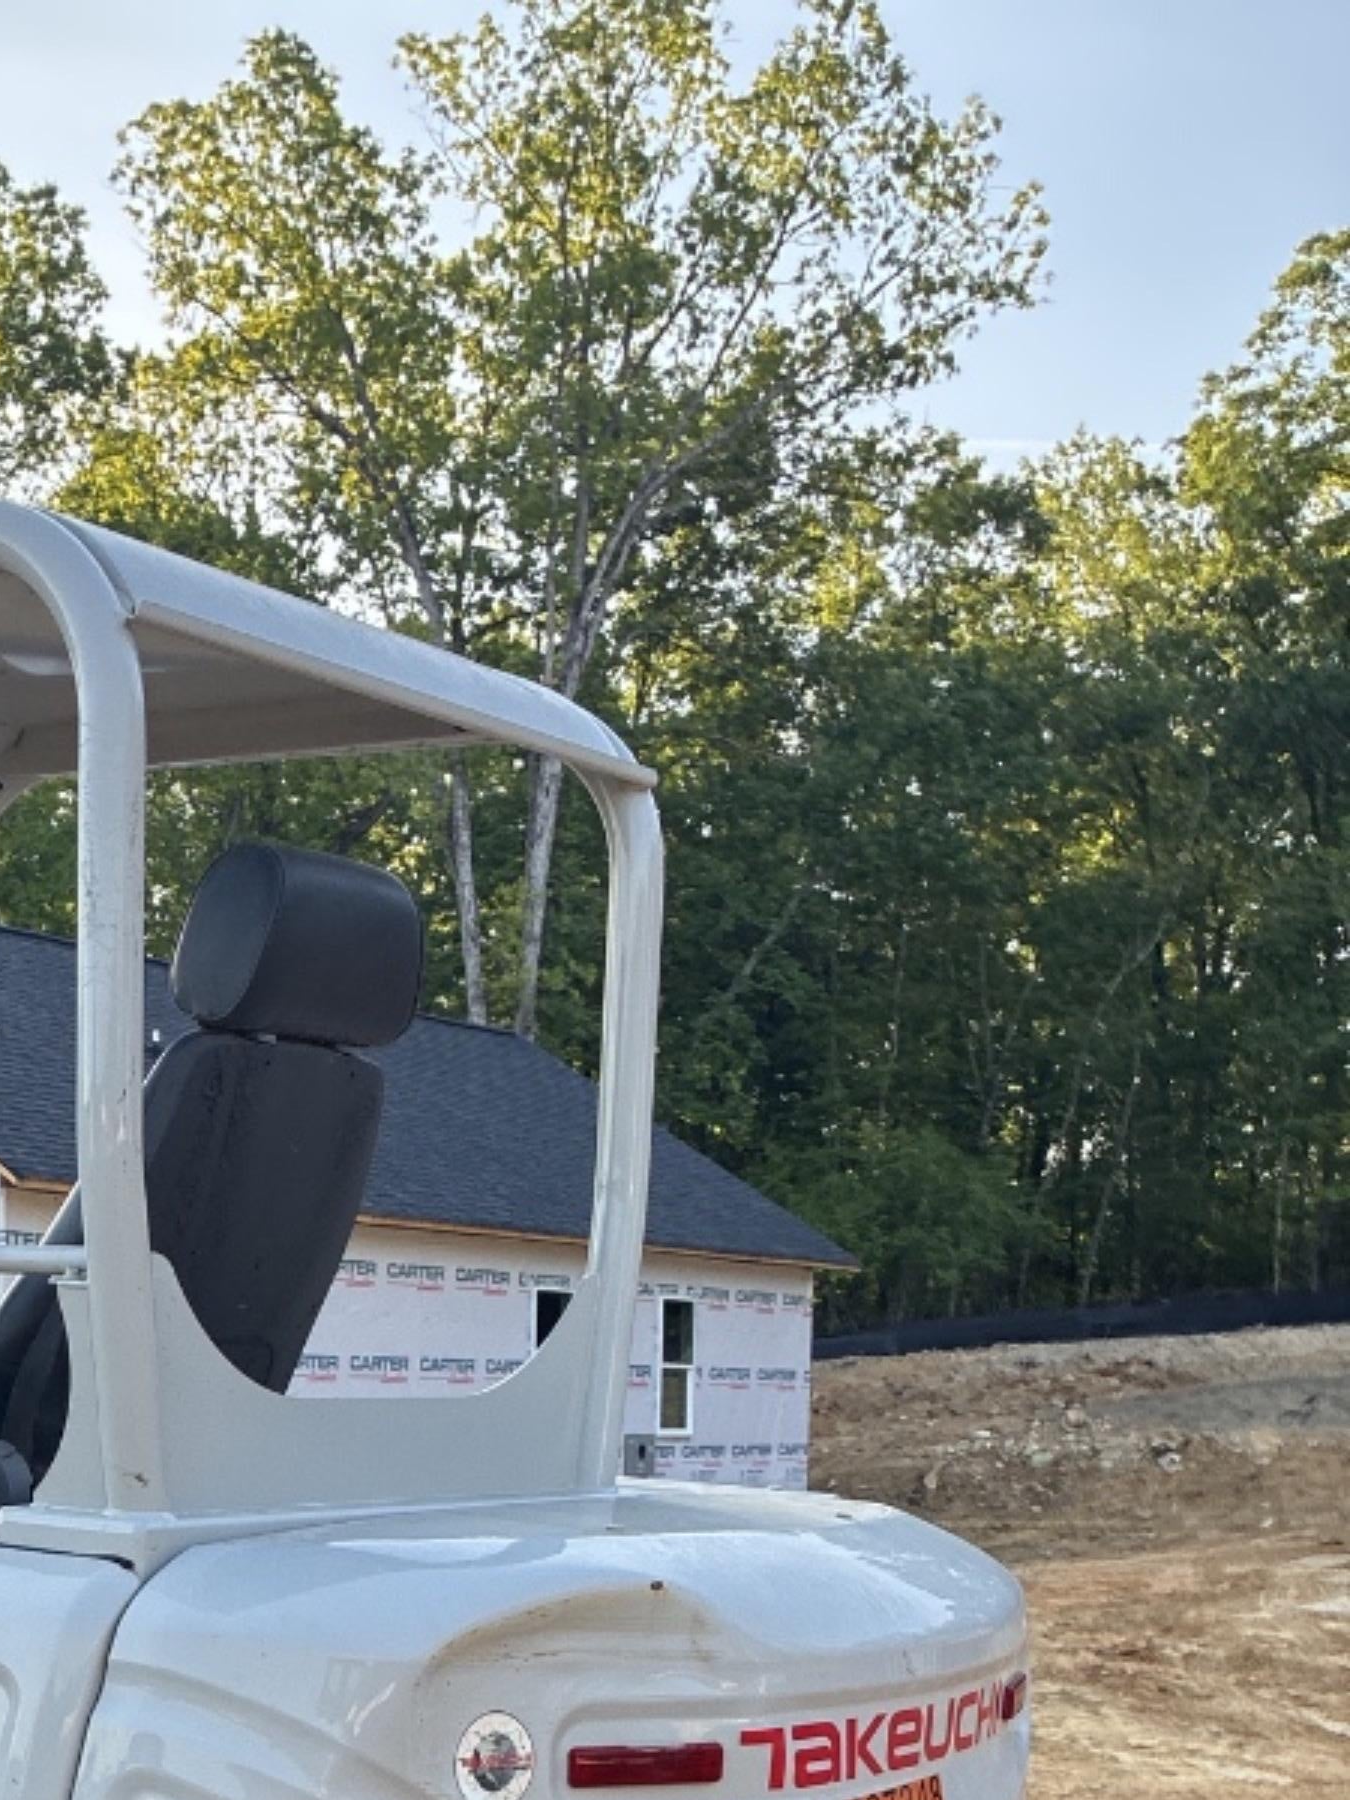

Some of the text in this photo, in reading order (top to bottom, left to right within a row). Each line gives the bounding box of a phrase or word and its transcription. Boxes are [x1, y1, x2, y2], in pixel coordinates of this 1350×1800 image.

[386, 1262, 445, 1282] CARTER
[455, 1266, 511, 1286] CARTER
[349, 1354, 410, 1373] CARTER
[418, 1357, 476, 1373] CARTER
